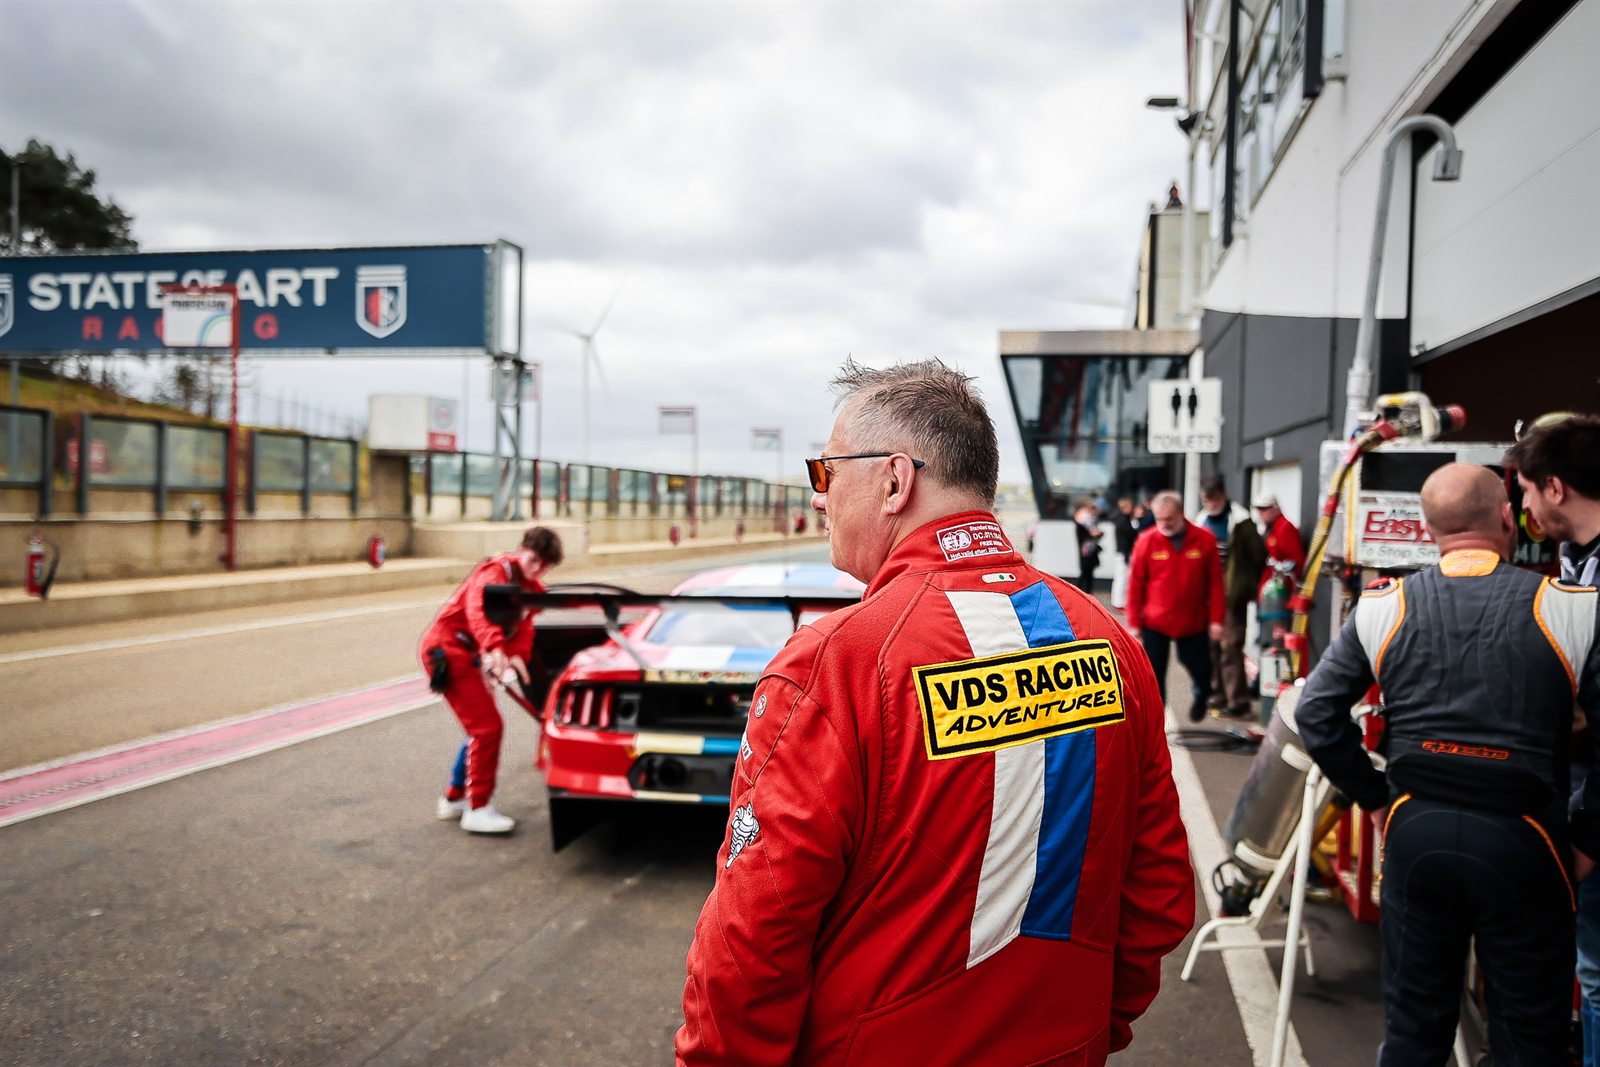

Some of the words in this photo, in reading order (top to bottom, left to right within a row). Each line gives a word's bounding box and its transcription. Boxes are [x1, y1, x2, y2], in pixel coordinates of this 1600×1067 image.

[28, 271, 178, 312] STATE
[235, 267, 340, 308] ART
[1152, 433, 1216, 449] TOILETS
[1377, 545, 1412, 559] Stop
[934, 673, 1008, 710] VDS
[1015, 655, 1113, 698] RACING
[945, 690, 1117, 736] ADVENTURES
